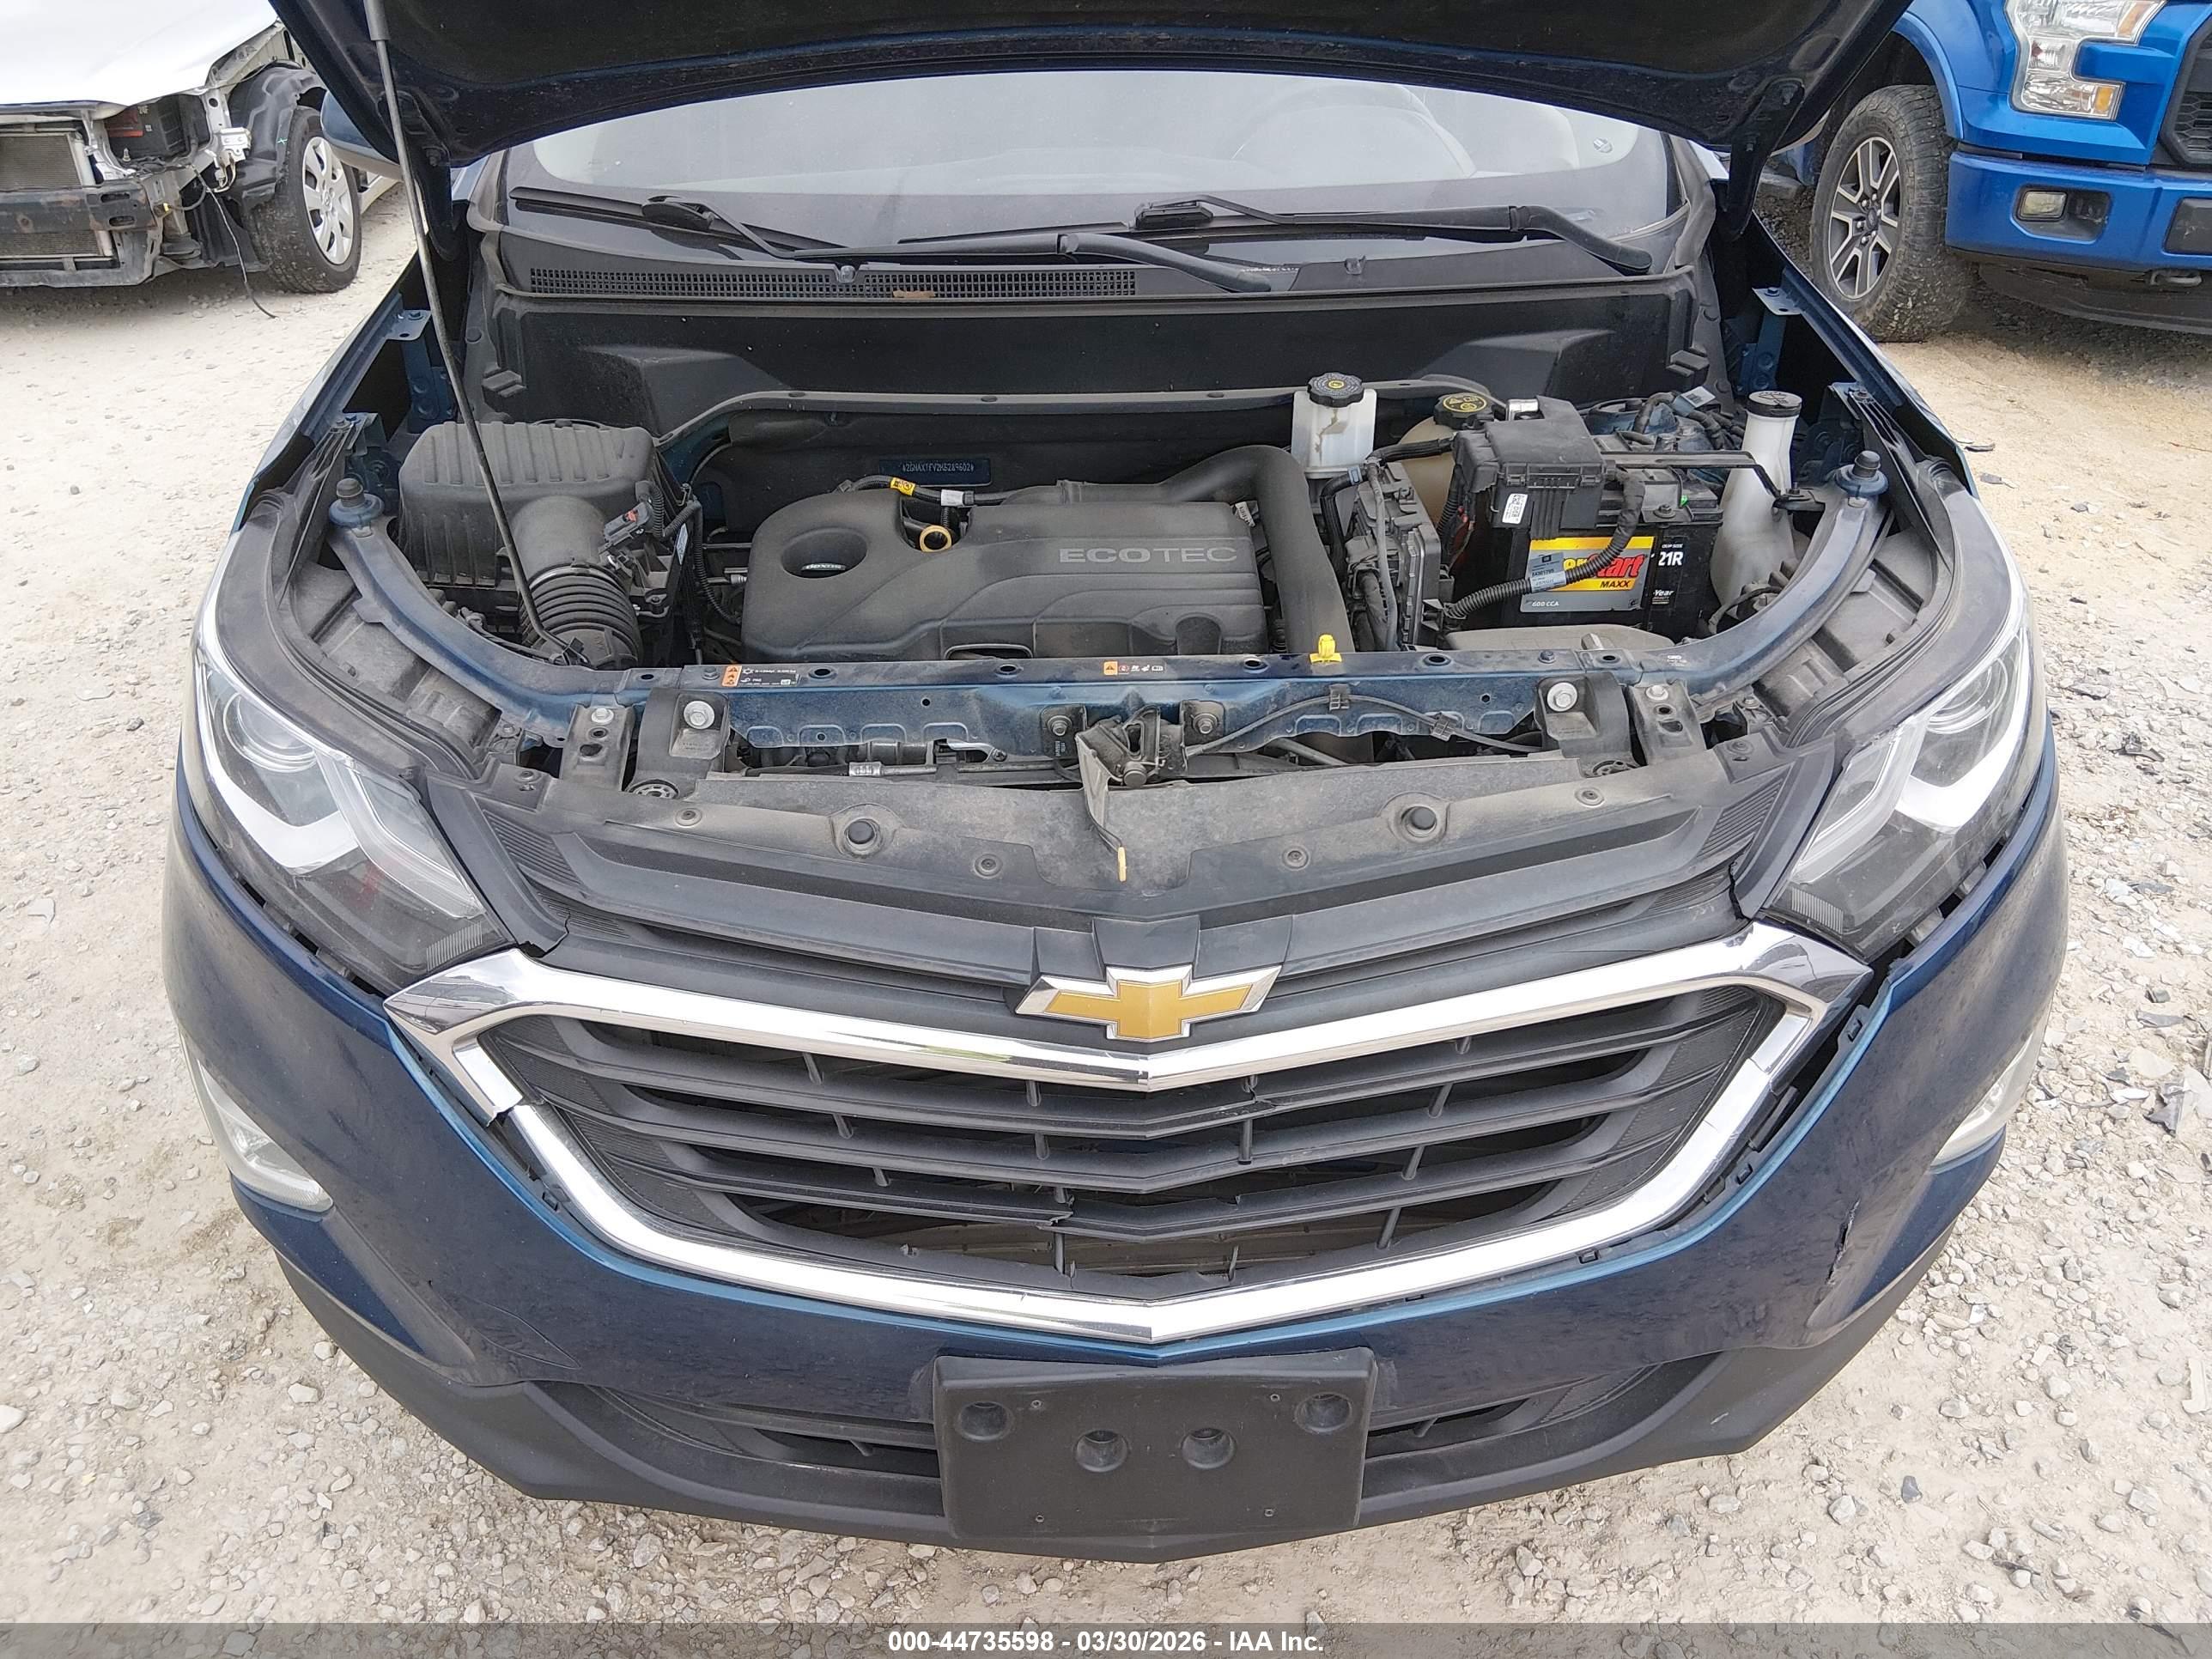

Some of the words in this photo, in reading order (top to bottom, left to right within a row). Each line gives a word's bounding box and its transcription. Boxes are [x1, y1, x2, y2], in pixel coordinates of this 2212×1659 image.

[1059, 546, 1237, 563] ECOTEC
[1657, 551, 1684, 567] 21R
[1600, 580, 1631, 588] MAXX
